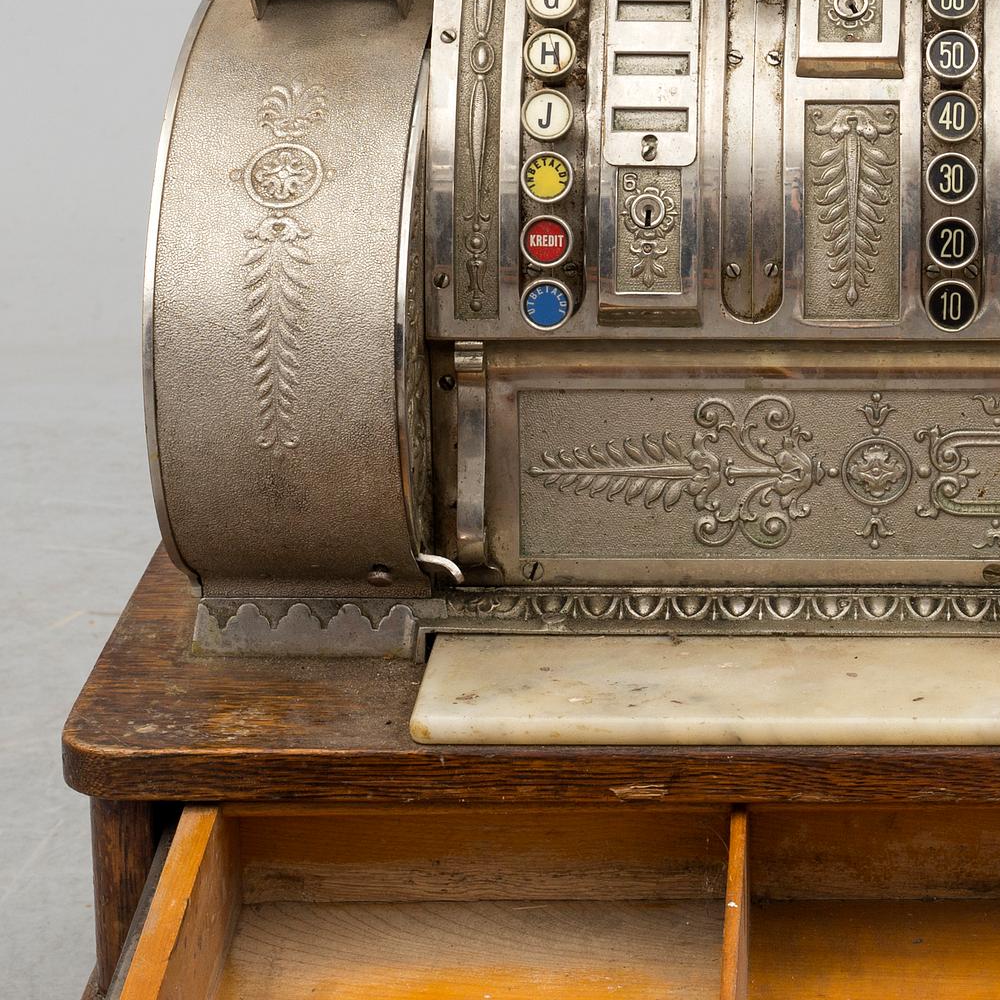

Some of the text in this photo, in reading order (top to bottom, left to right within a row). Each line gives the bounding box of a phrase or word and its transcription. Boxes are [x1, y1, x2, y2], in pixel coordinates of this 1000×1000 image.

[540, 42, 560, 66] H
[939, 41, 964, 70] 50
[538, 102, 552, 129] J
[938, 101, 965, 131] 40
[622, 172, 638, 192] 6
[939, 164, 964, 194] 30
[529, 234, 564, 248] KREDIT
[940, 228, 964, 258] 20
[940, 292, 962, 321] 10
